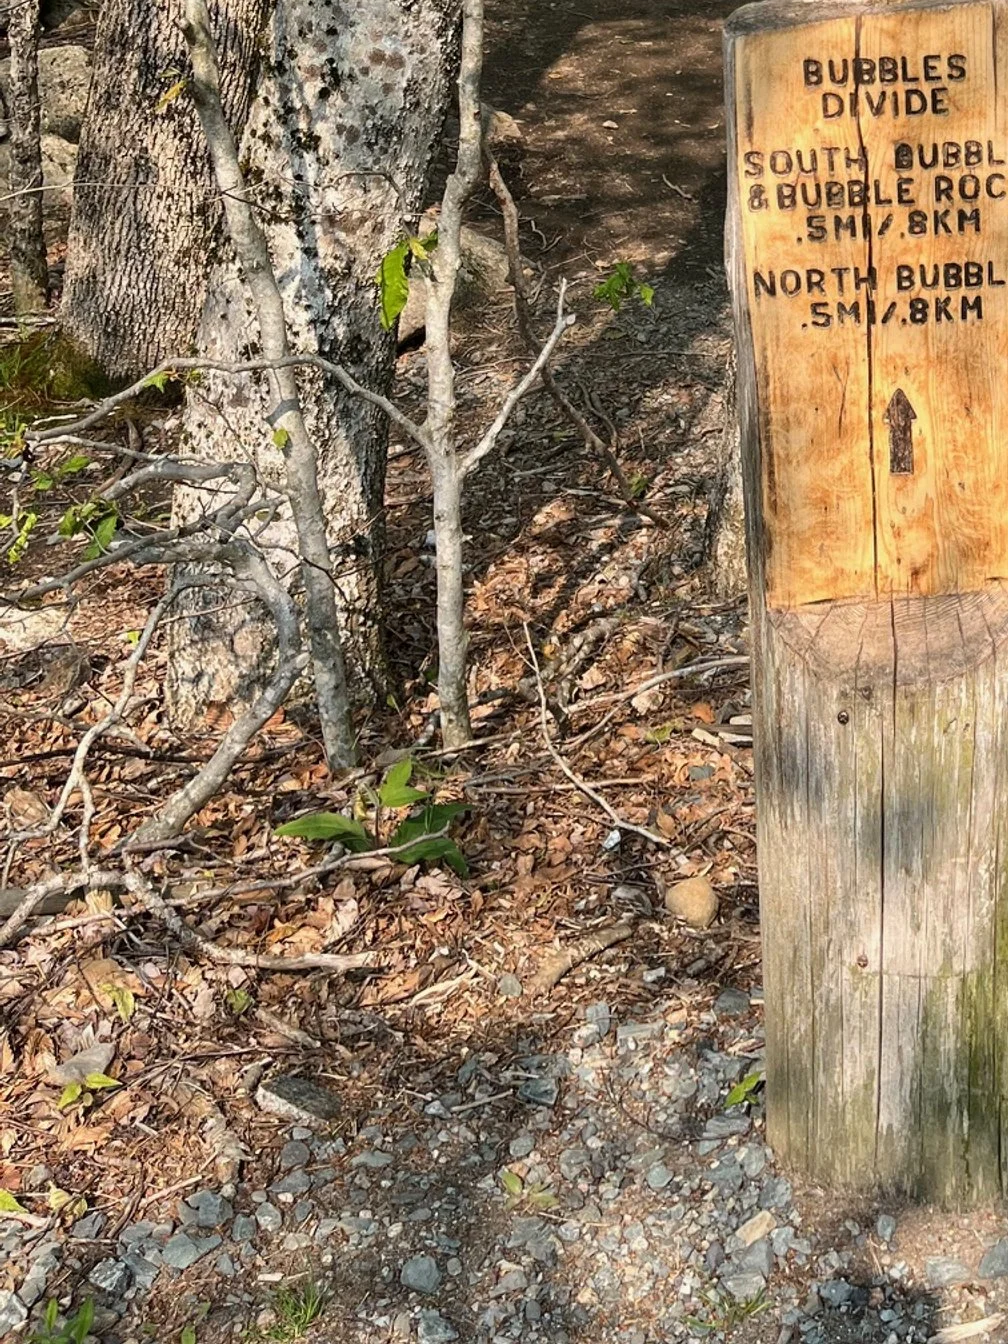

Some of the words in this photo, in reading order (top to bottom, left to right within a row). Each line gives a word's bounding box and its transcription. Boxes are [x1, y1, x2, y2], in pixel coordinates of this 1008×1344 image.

[803, 54, 967, 87] BUBBLES
[822, 88, 950, 120] DIVIDE
[744, 146, 868, 178] SOUTH
[754, 268, 877, 299] NORTH
